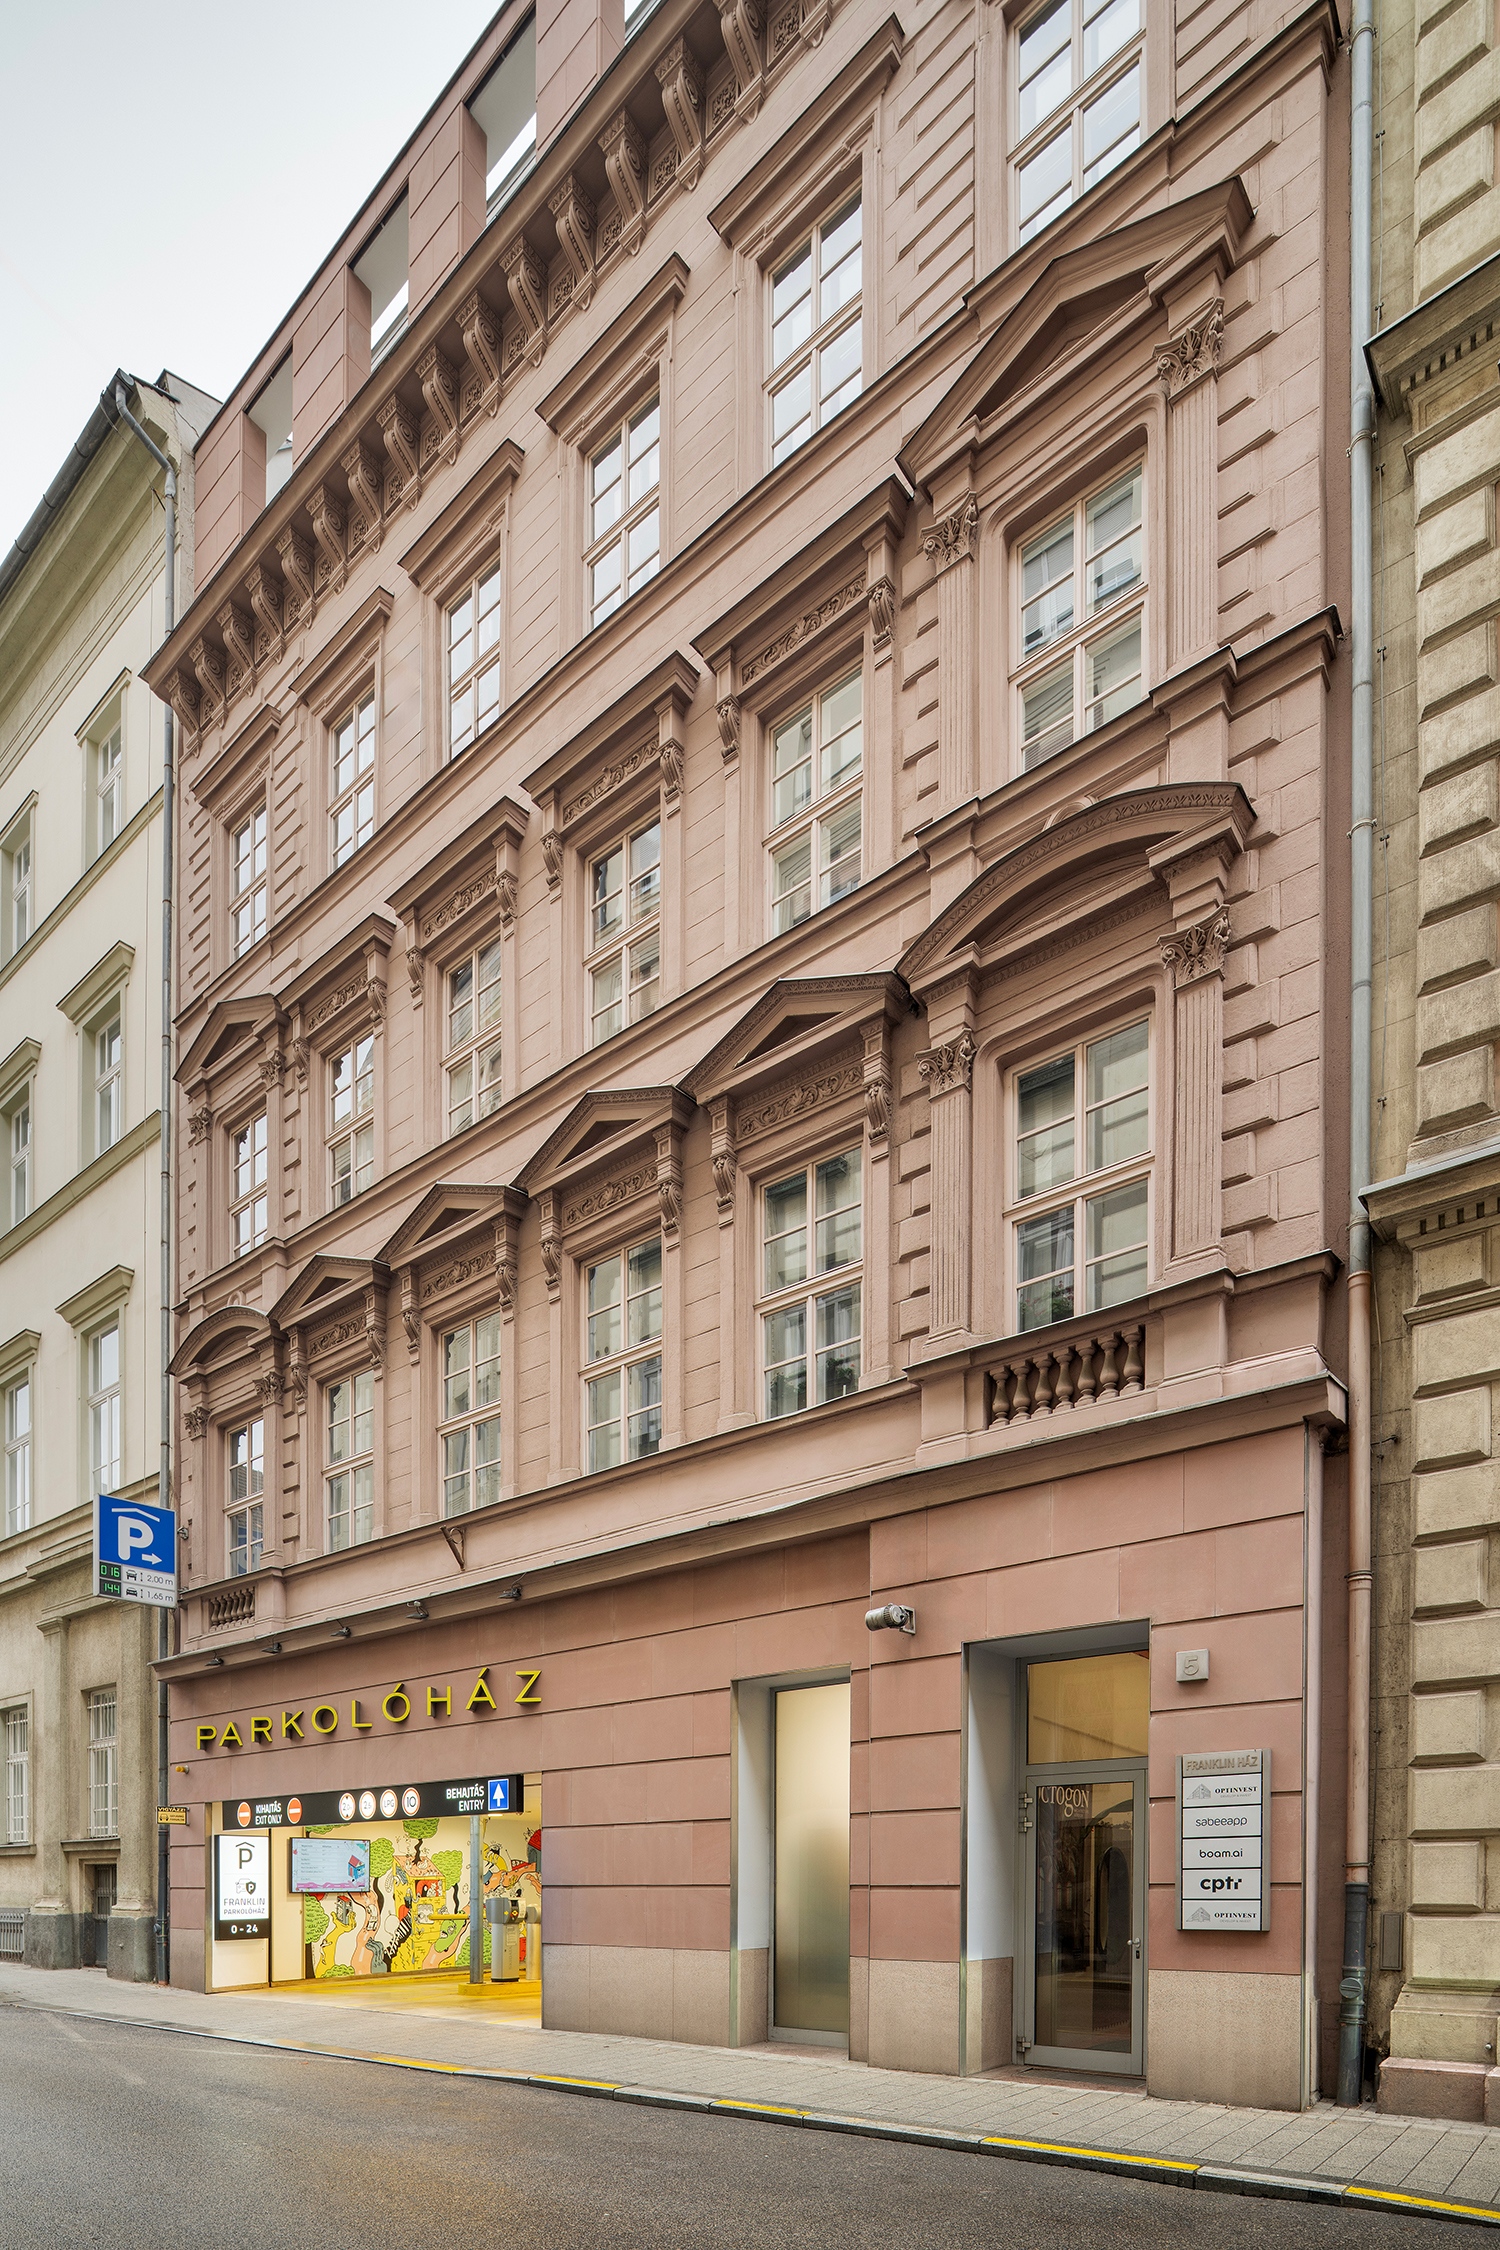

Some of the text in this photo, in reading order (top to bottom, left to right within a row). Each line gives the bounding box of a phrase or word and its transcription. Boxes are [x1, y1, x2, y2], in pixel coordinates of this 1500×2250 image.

[118, 1516, 154, 1560] P
[103, 1582, 120, 1594] 144
[165, 1578, 174, 1586] m
[165, 1594, 174, 1602] m
[1183, 1655, 1199, 1676] 5
[196, 1667, 543, 1751] PARKOLÓHÁZ
[1186, 1755, 1258, 1771] FRANKLIN HÁZ
[446, 1783, 485, 1800] BEHAJTÁS
[1214, 1786, 1258, 1794] OPTINVEST
[406, 1796, 417, 1808] 10
[458, 1800, 485, 1812] ENTRY
[255, 1814, 282, 1825] EXIT ONLY
[239, 1848, 252, 1869] P
[1199, 1848, 1243, 1858] boam.ai
[1200, 1876, 1242, 1893] cptr
[223, 1898, 265, 1906] FRANKLIN
[223, 1907, 265, 1915] PARKOLÓHÁZ
